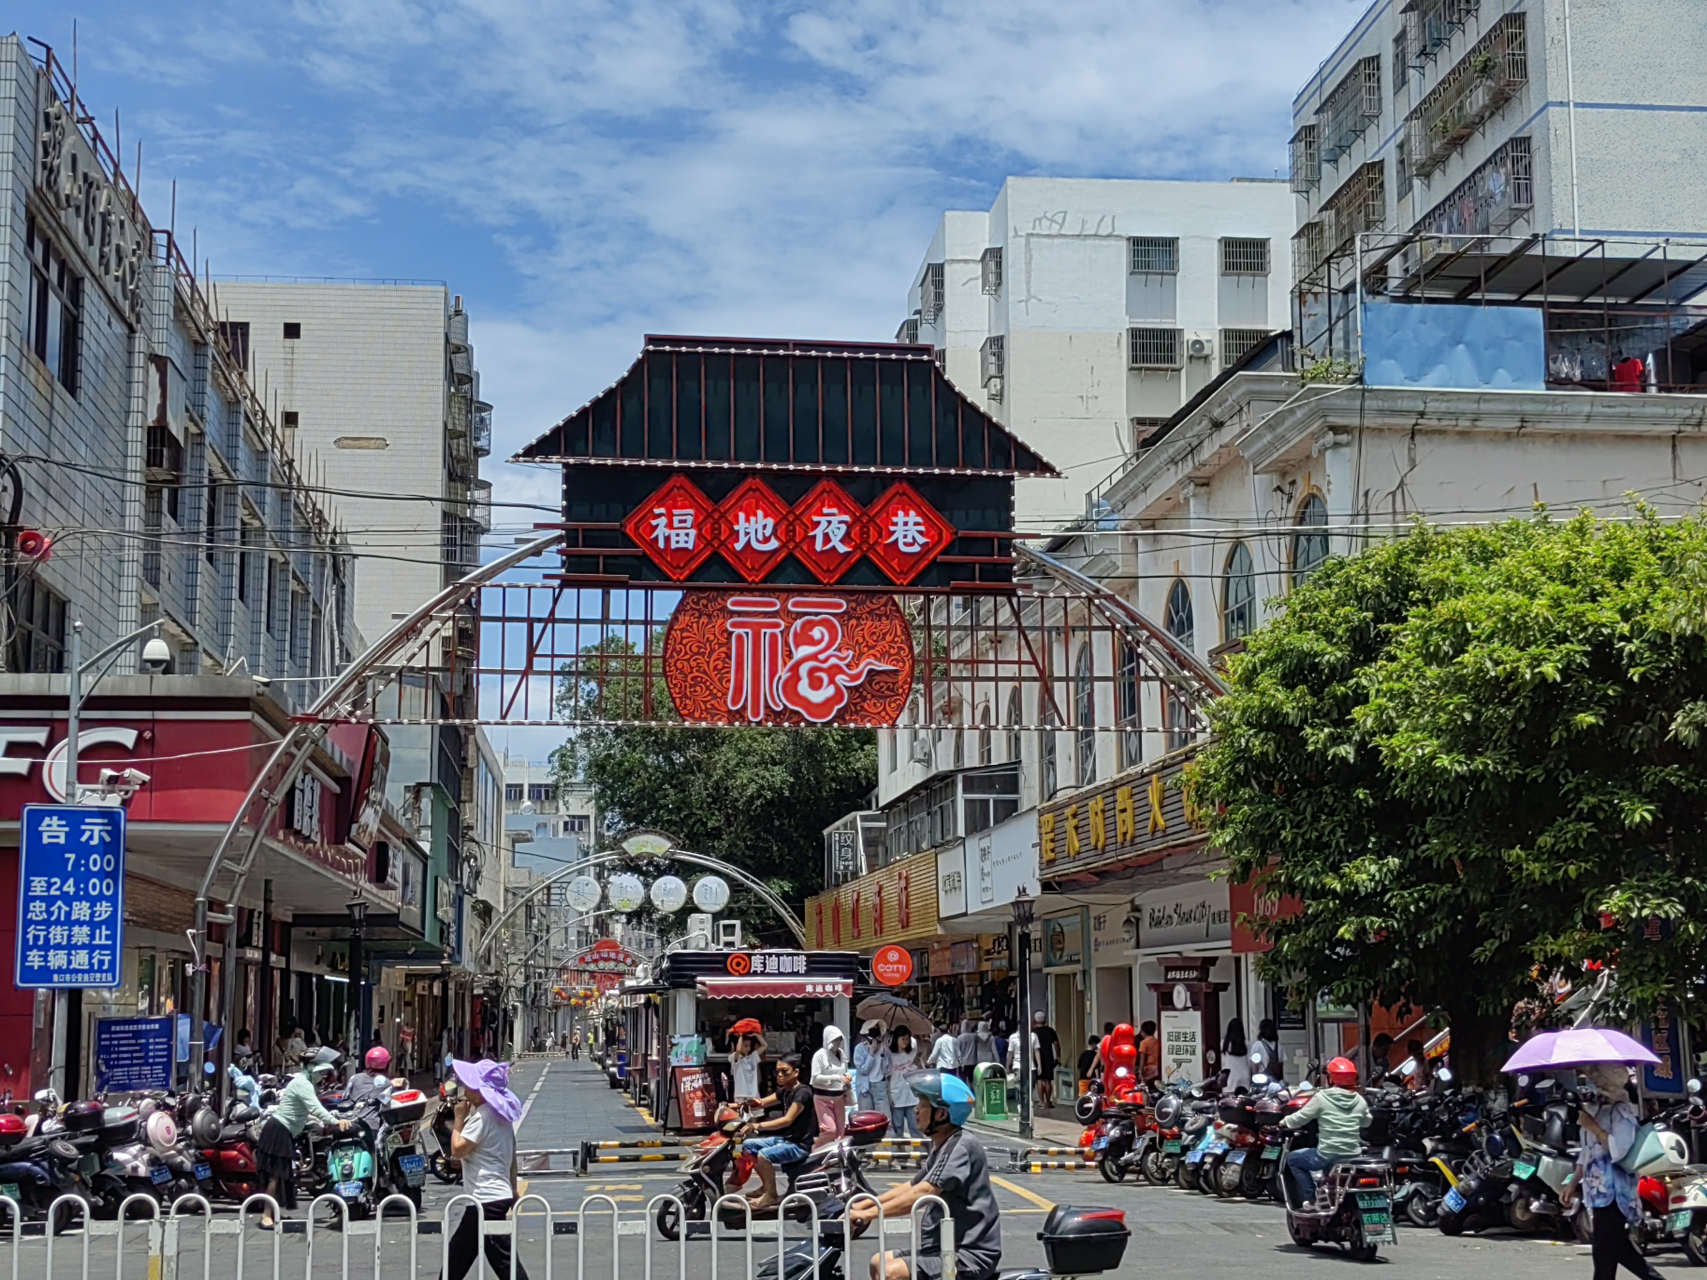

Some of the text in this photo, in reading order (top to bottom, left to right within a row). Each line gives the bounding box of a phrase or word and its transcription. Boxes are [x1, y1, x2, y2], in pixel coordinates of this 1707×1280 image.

[650, 507, 930, 553] 福地夜巷
[38, 816, 112, 845] 告示
[840, 833, 853, 860] 纹身
[64, 853, 115, 871] 7:00
[28, 877, 114, 896] 至24:00
[27, 900, 113, 921] 忠介路步
[26, 924, 112, 945] 行街禁止
[25, 949, 112, 970] 车辆通行
[750, 954, 807, 974] 库迪咖啡
[878, 963, 907, 973] COTTI
[805, 984, 843, 993] 库迪咖啡
[1167, 1031, 1197, 1042] 低碳生活
[1167, 1044, 1197, 1056] 绿色环保
